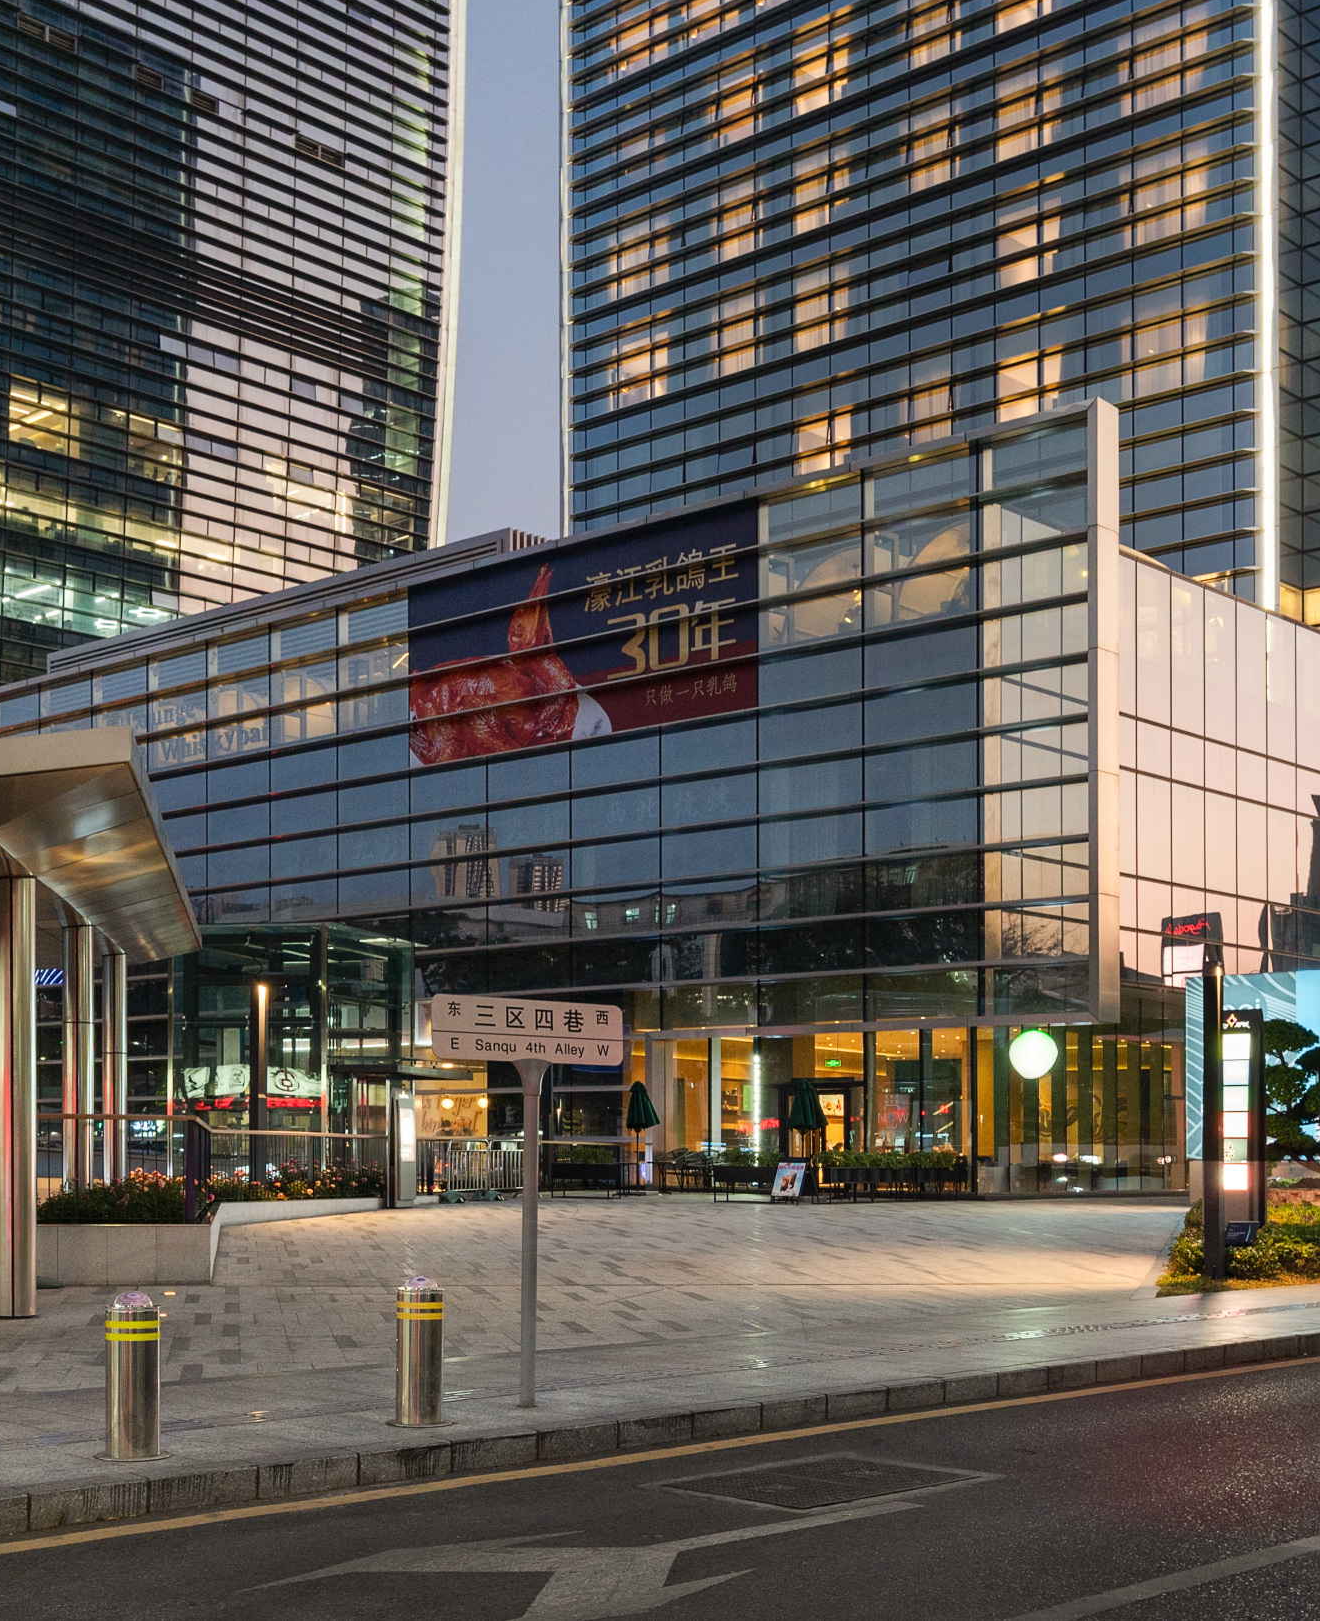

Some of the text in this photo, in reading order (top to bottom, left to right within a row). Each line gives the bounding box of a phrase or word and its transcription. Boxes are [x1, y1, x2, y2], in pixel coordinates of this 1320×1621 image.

[607, 597, 736, 680] 30年
[645, 672, 738, 708] 只做一只乳鸽
[447, 1000, 609, 1033] 东 三区四巷 西
[450, 1037, 610, 1059] E Sanqu 4th Alley W
